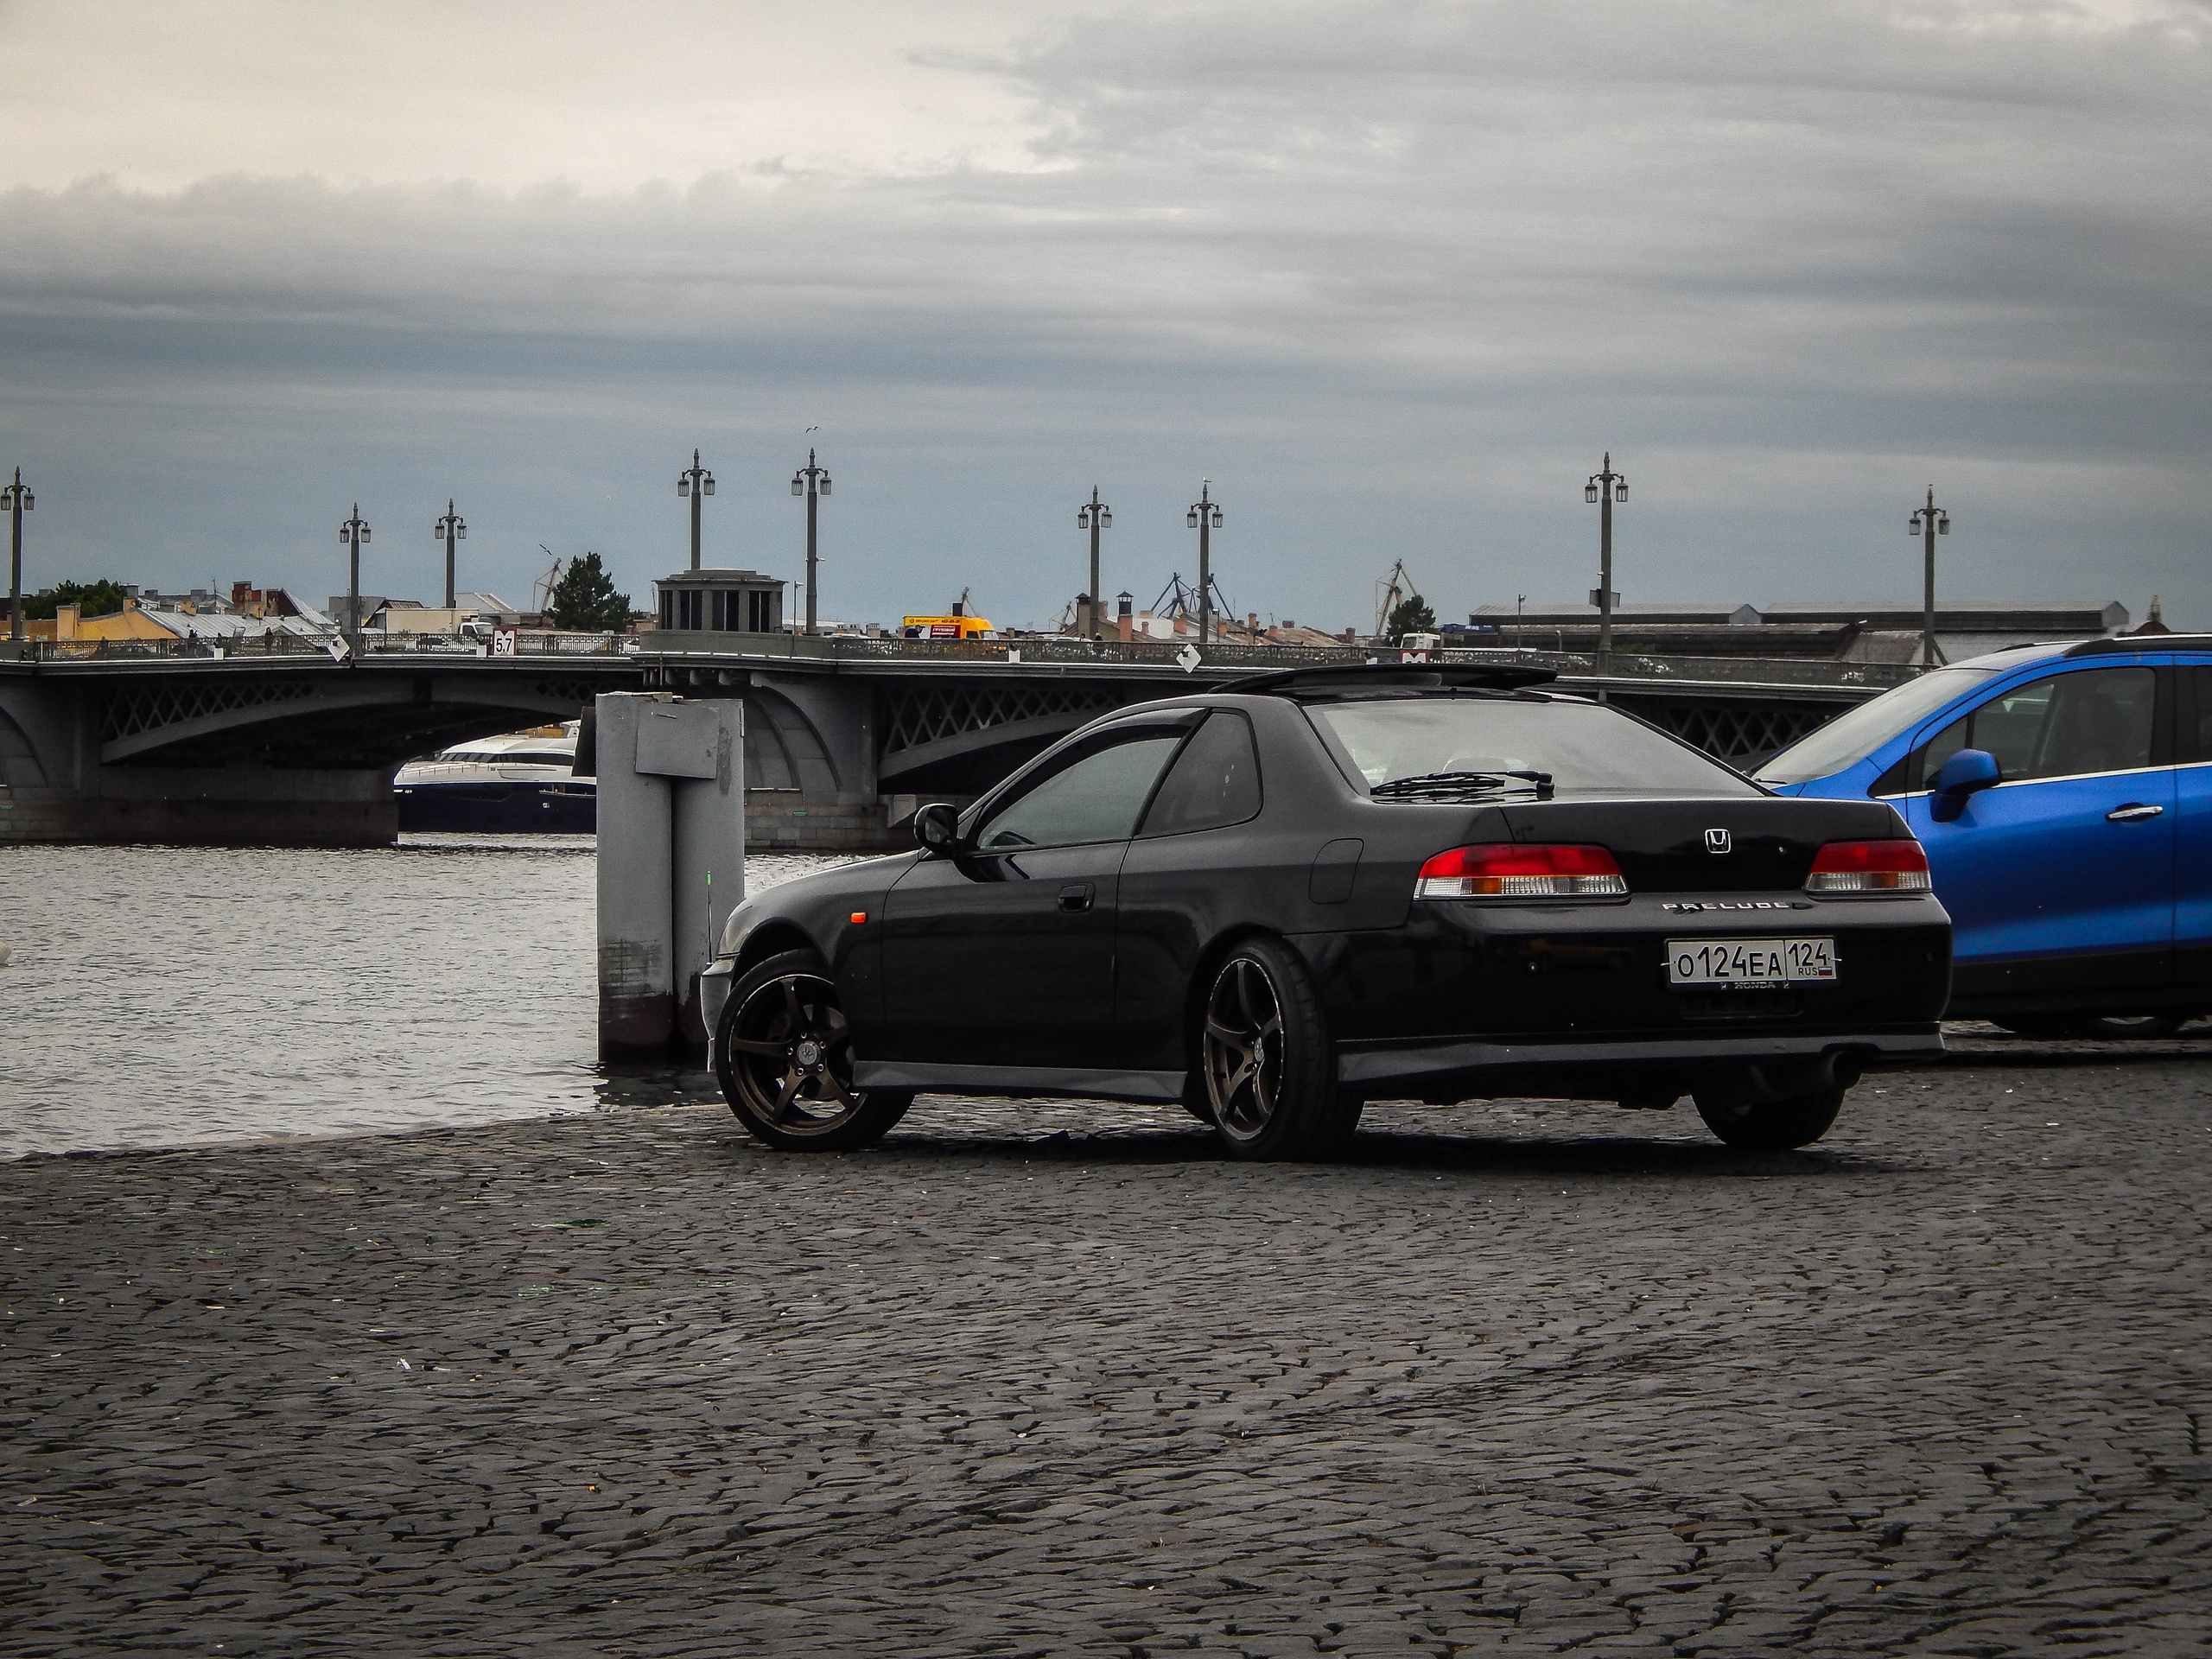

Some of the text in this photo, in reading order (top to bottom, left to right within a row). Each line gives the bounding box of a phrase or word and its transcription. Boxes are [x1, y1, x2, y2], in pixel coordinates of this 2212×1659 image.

[496, 638, 512, 652] 5.7
[1662, 901, 1789, 910] PRELUDE
[1677, 942, 1827, 978] O124EA 124
[1798, 967, 1818, 976] RUS
